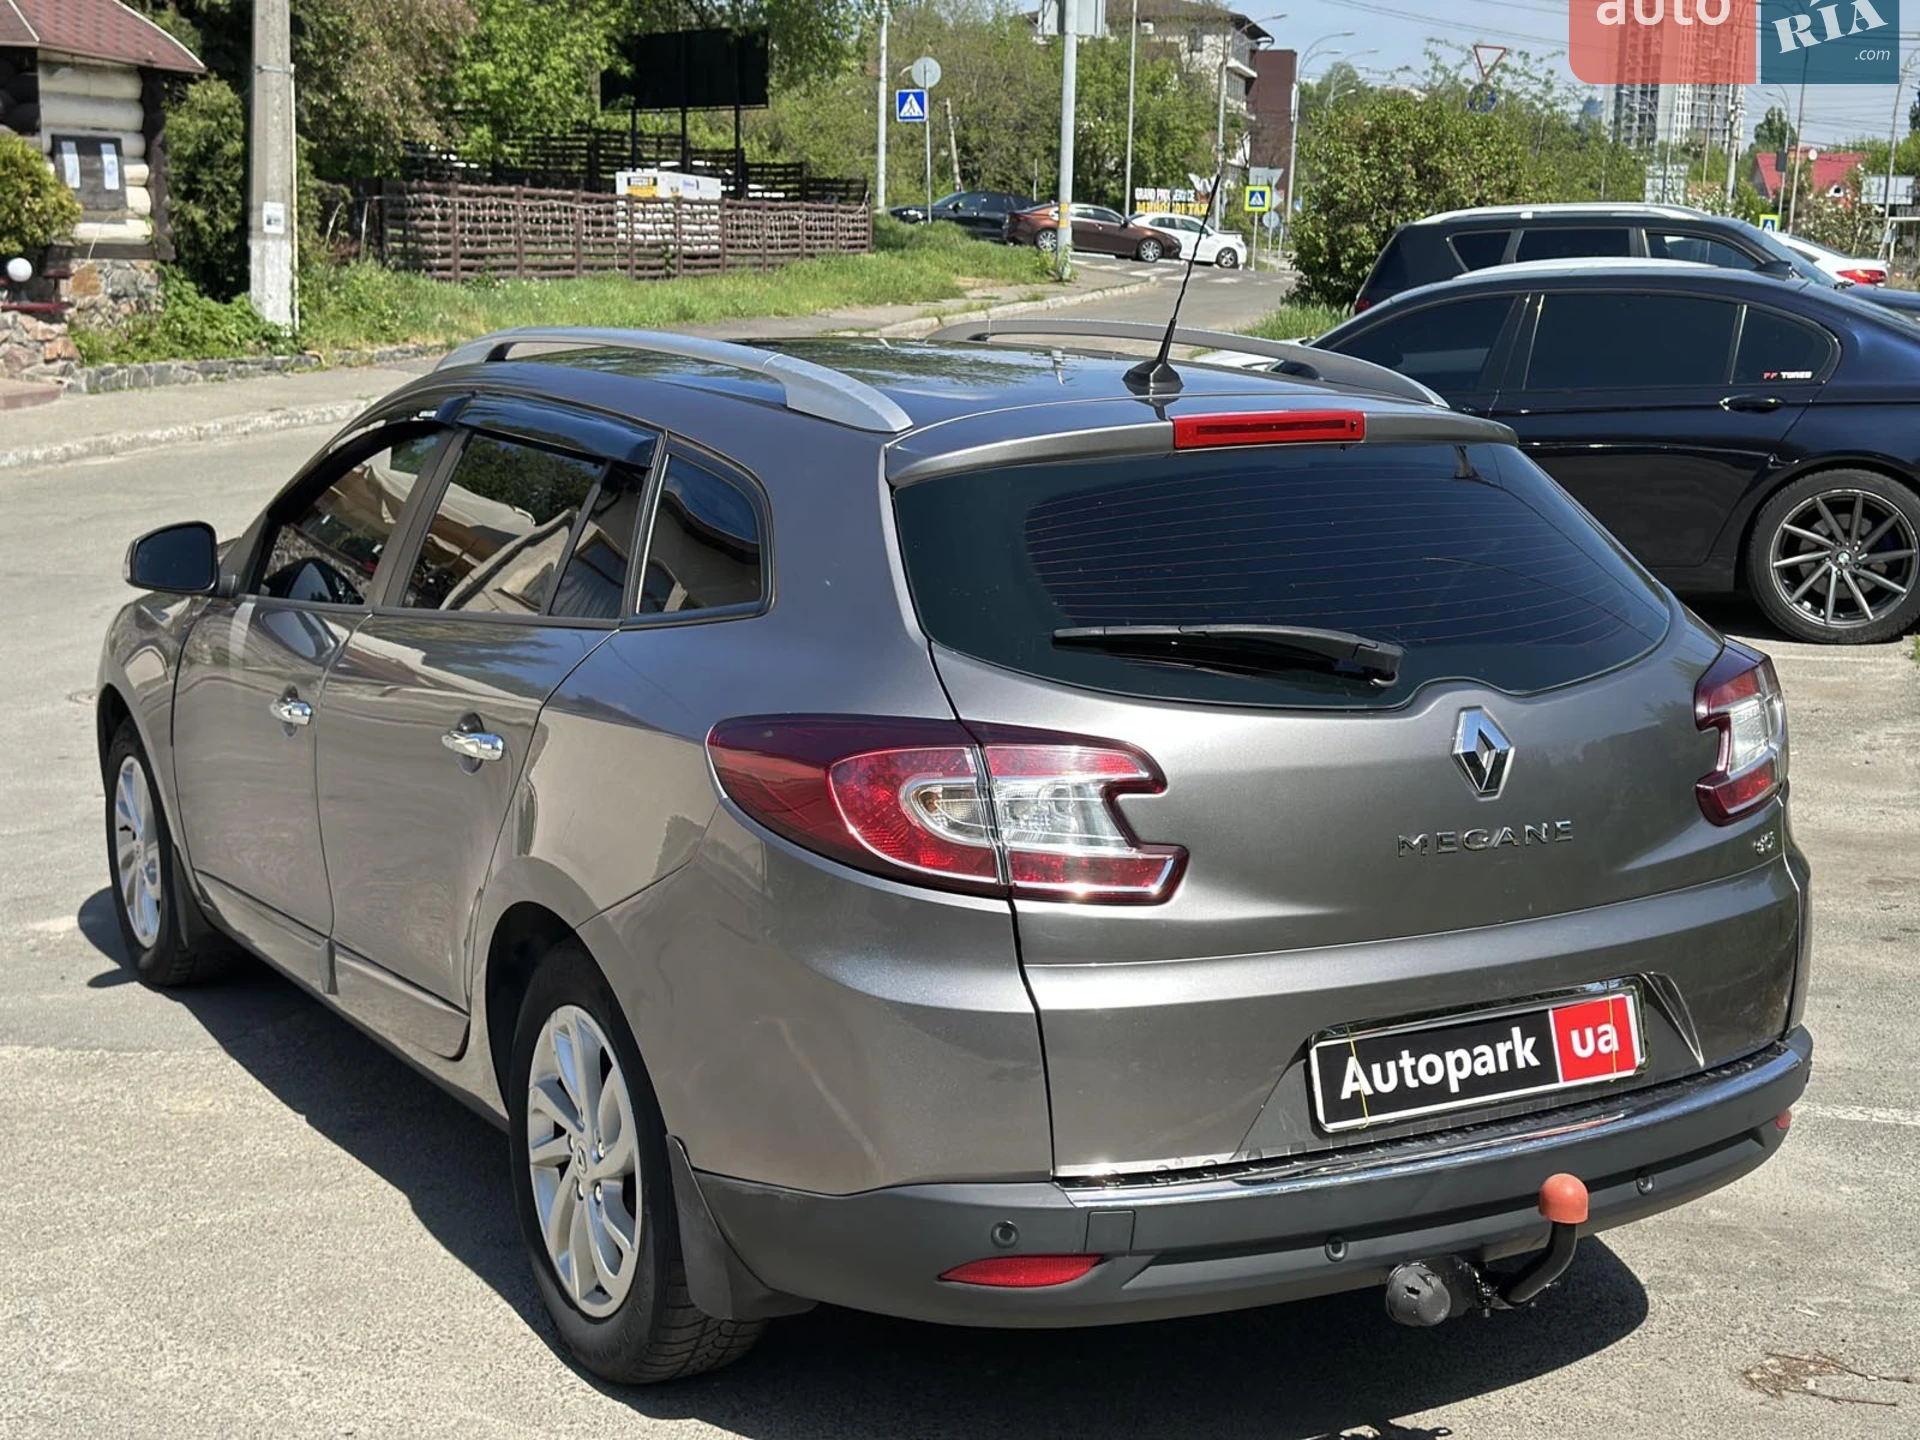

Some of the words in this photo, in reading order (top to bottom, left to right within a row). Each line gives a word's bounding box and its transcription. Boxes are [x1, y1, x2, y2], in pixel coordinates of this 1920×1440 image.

[1397, 820, 1575, 858] MEGANE
[1340, 1026, 1541, 1101] Autopark
[1570, 1022, 1619, 1059] ua
